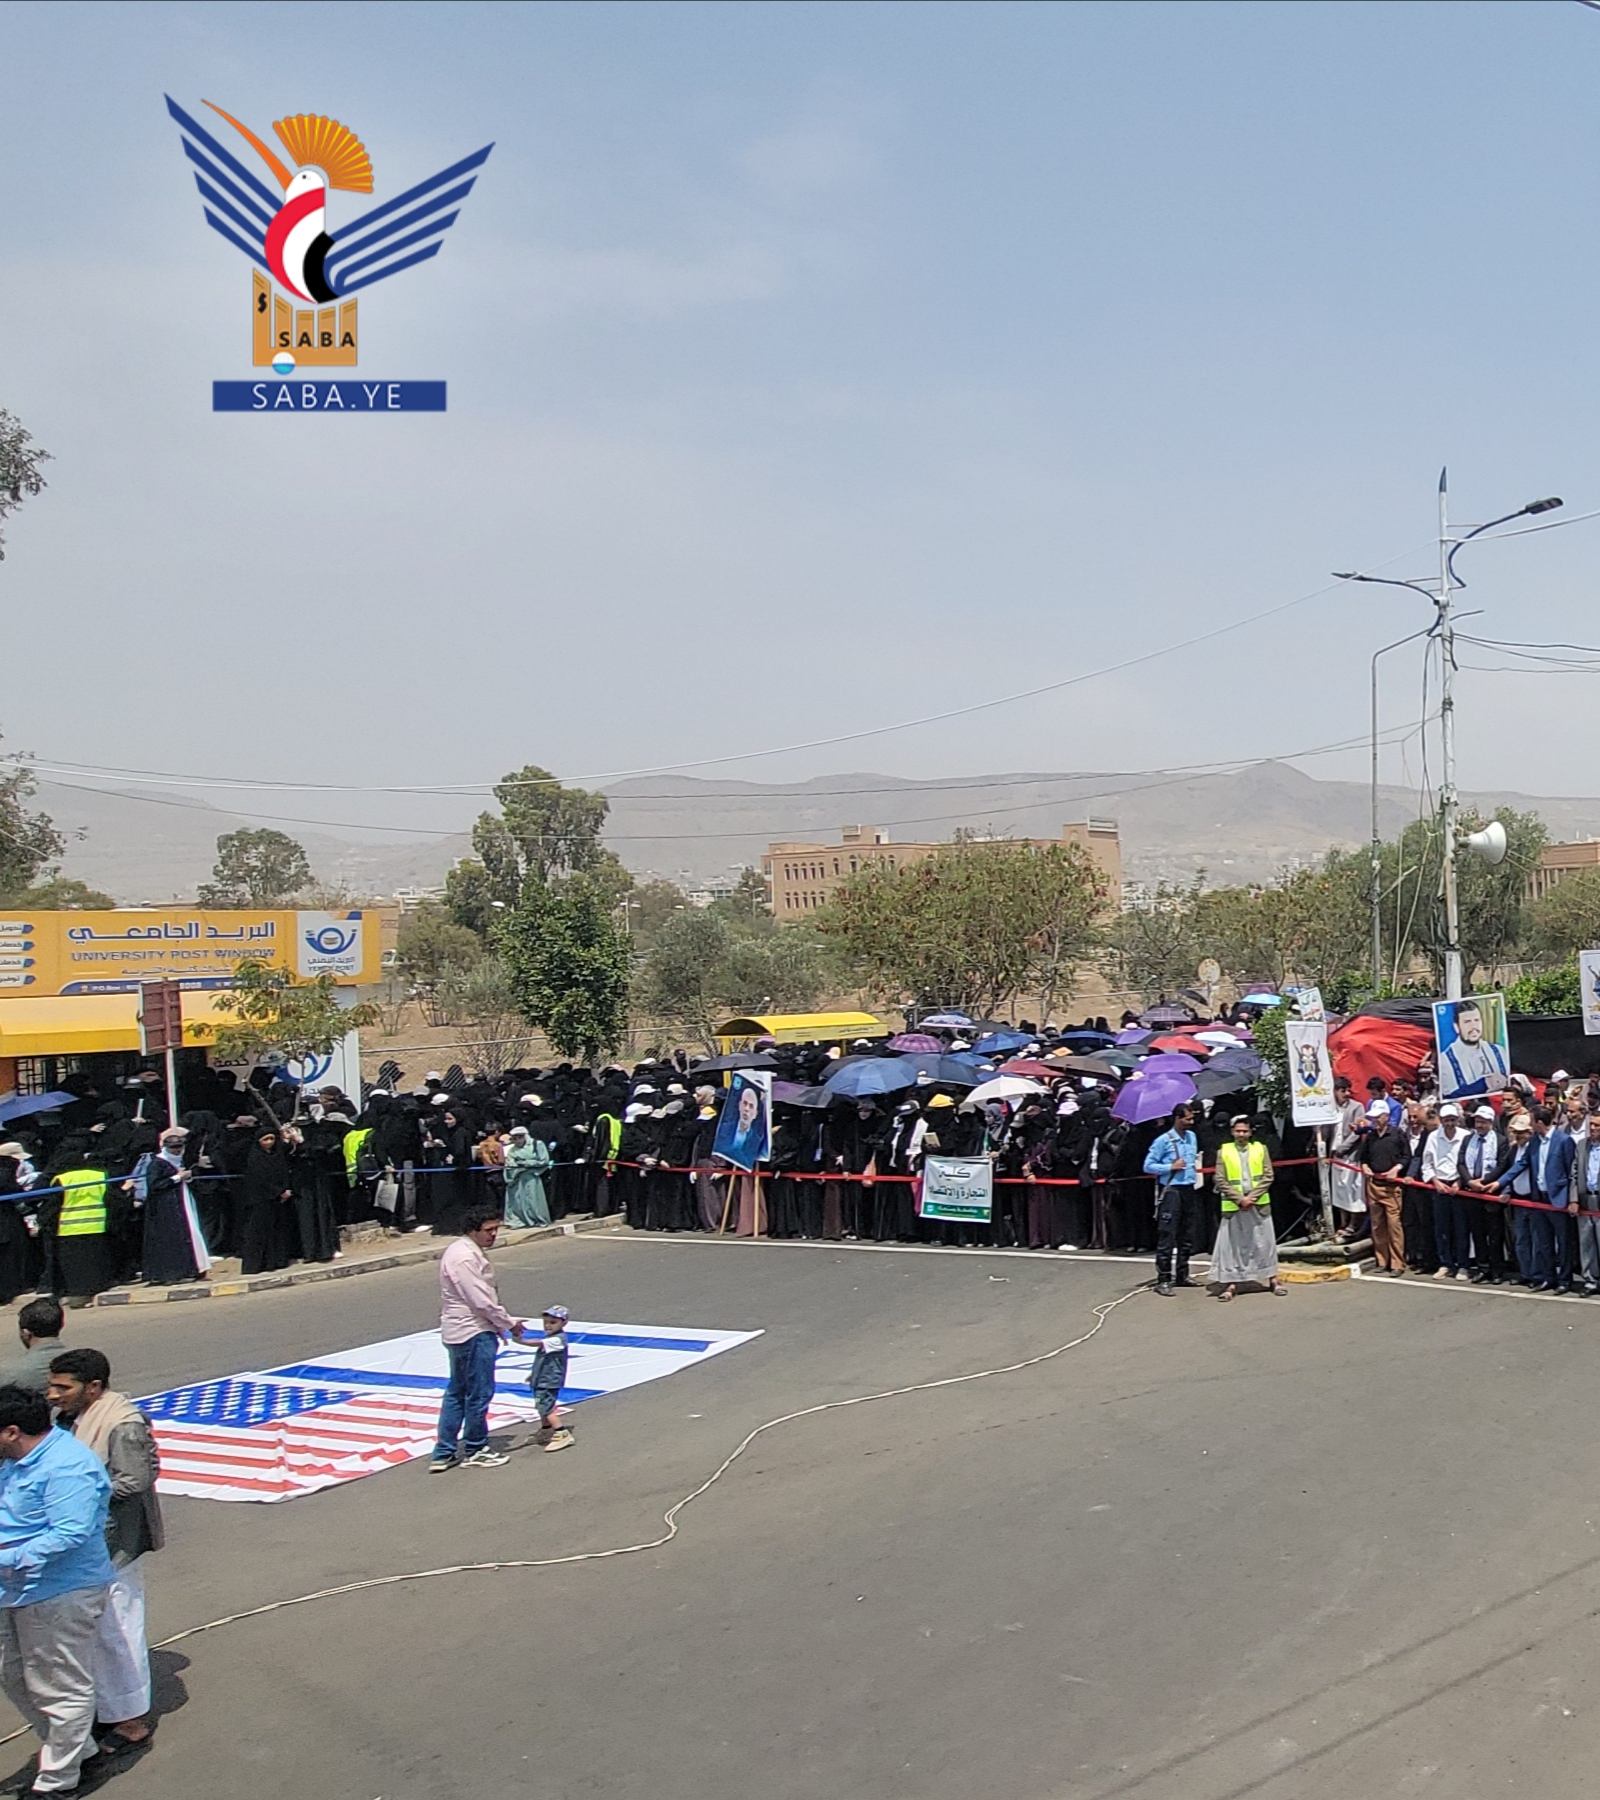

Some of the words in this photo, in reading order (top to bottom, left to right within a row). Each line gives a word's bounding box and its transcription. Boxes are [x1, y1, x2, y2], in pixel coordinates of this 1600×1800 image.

[68, 922, 199, 945] الجامعي
[205, 922, 275, 941] البريد
[71, 951, 166, 962] UNIVERSITY
[171, 950, 210, 959] POST
[215, 949, 275, 958] WINDOW
[939, 1165, 971, 1181] كلية
[960, 1187, 988, 1200] التجارة
